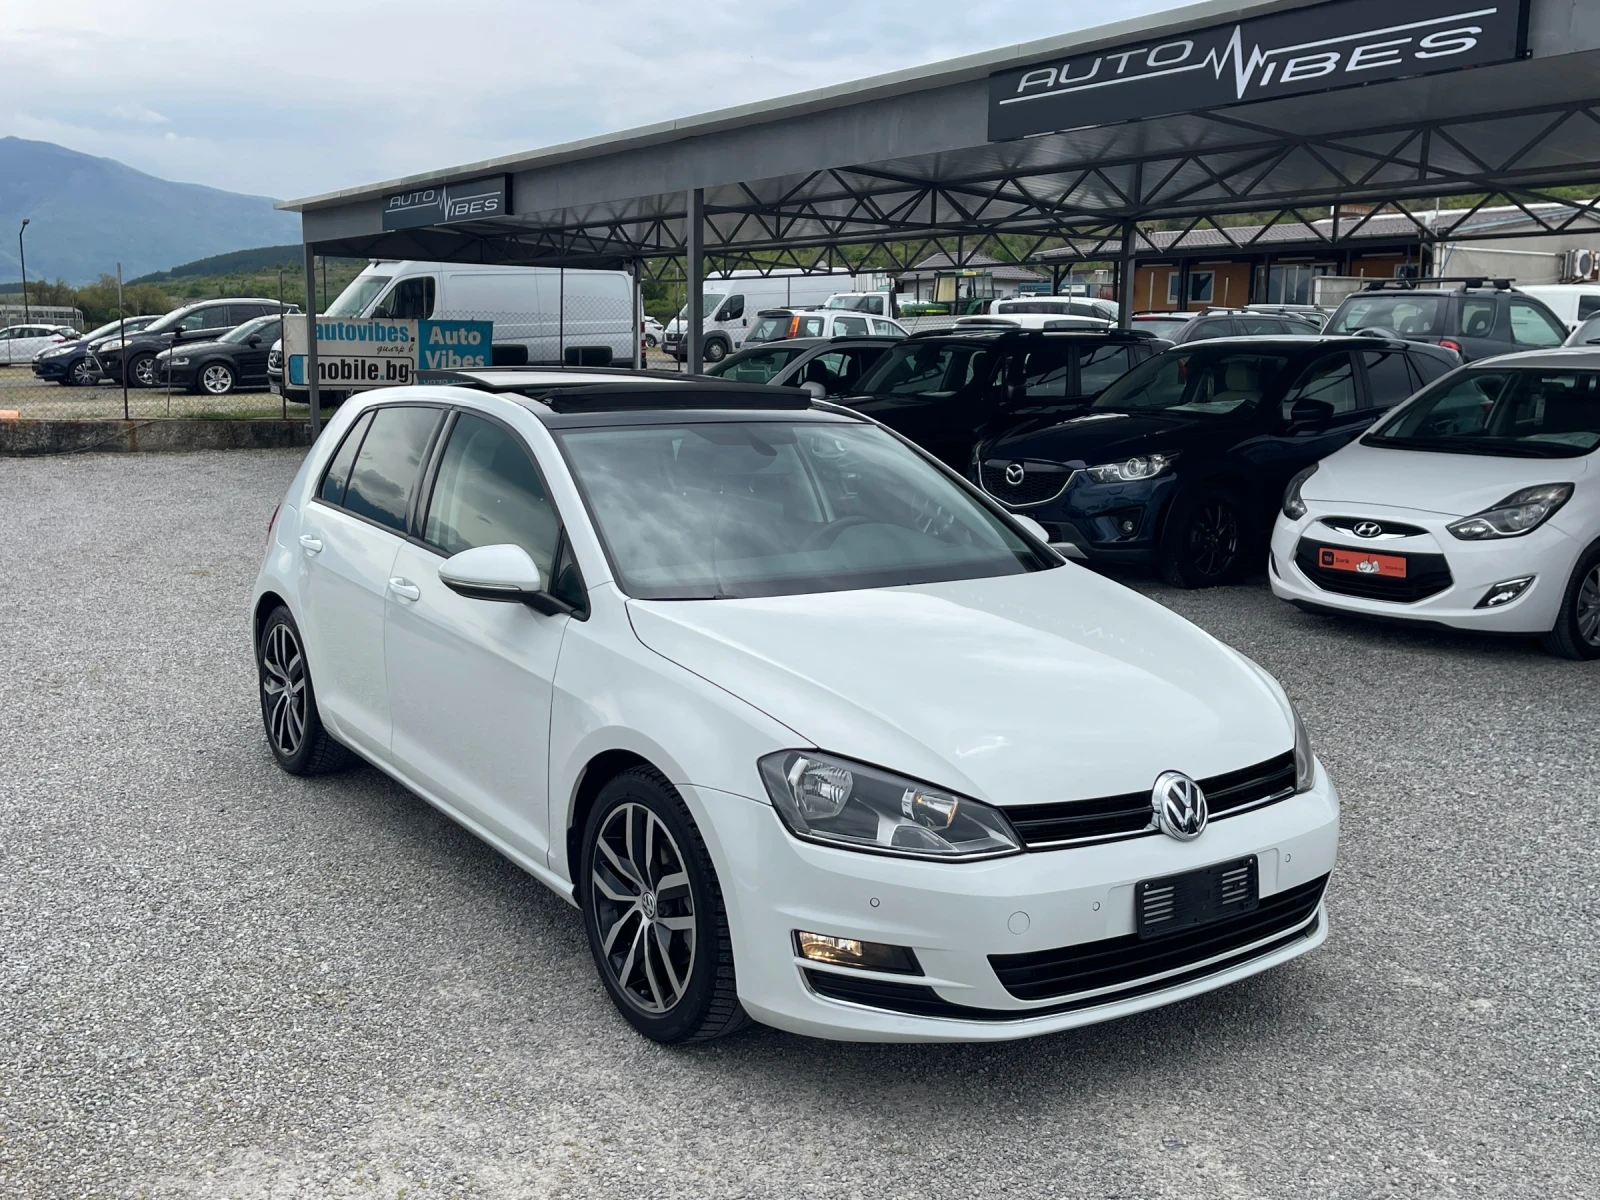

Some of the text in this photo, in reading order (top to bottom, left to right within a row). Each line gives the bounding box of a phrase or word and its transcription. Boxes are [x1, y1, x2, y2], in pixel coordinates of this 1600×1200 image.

[1016, 39, 1195, 93] AUTO
[389, 189, 435, 208] AUTO
[428, 325, 482, 346] Auto
[425, 349, 485, 370] Vibes
